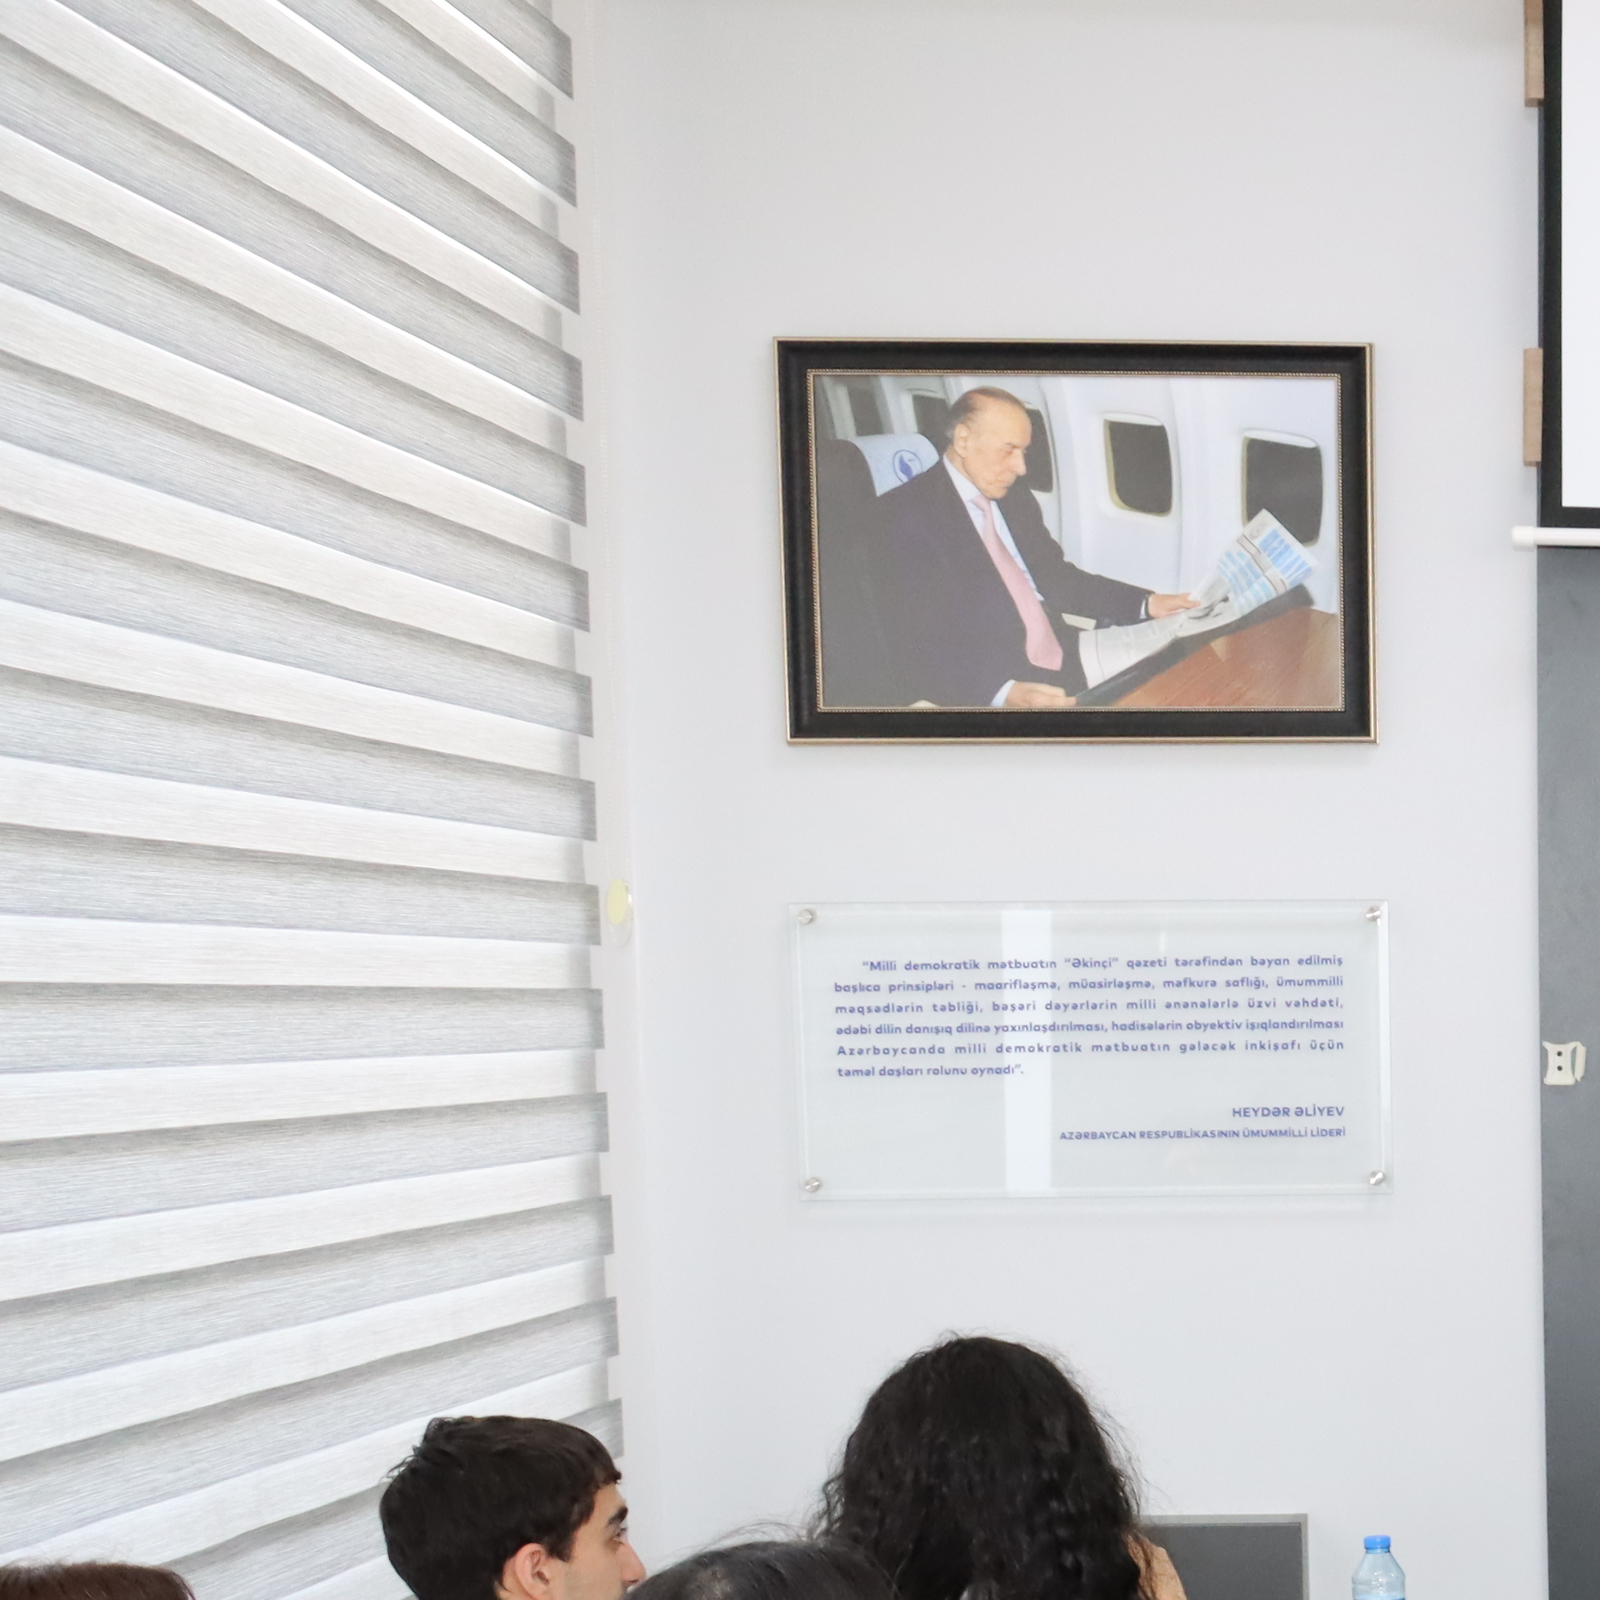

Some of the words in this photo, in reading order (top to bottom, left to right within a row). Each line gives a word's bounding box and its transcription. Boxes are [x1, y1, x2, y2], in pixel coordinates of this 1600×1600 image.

[904, 959, 980, 970] demokratik
[987, 959, 1056, 969] mətbuatın
[1126, 956, 1166, 970] qəzeti
[1174, 956, 1242, 966] tərəfindən
[1250, 955, 1290, 968] bəyan
[1296, 954, 1342, 966] edilmiş
[834, 982, 880, 993] başlıca
[888, 980, 954, 993] prinsipləri
[974, 978, 1060, 990] maarifləşmə,
[1068, 978, 1154, 990] müasirləşmə,
[1162, 977, 1217, 987] məfkurə
[1224, 976, 1268, 989] saflığı,
[1276, 975, 1343, 986] ümummilli
[834, 1002, 923, 1015] məqsədlərin
[932, 1001, 982, 1014] təbliği,
[992, 1000, 1036, 1012] bəşəri
[1044, 999, 1117, 1012] dəyərlərin
[1126, 998, 1156, 1009] milli
[1164, 998, 1238, 1009] ənənələrlə
[1247, 997, 1276, 1008] üzvi
[1284, 997, 1343, 1008] vəhdəti,
[835, 1024, 871, 1035] ədəbi
[874, 1023, 902, 1034] dilin
[905, 1023, 952, 1035] danışıq
[955, 1022, 990, 1033] dilinə
[1111, 1020, 1182, 1031] hadisələrin
[1185, 1019, 1242, 1032] obyektiv
[836, 1044, 945, 1057] Azərbaycanda
[954, 1043, 986, 1053] milli
[995, 1042, 1082, 1053] demokratik
[1091, 1041, 1170, 1052] mətbuatın
[1178, 1040, 1235, 1054] gələcək
[1244, 1039, 1300, 1051] inkişafı
[1309, 1039, 1344, 1051] üçün
[837, 1066, 875, 1077] təməl
[878, 1066, 923, 1077] daşları
[926, 1065, 967, 1075] rolunu
[1232, 1106, 1290, 1117] HEYDƏR
[1294, 1103, 1344, 1117] ƏLİYEV
[1059, 1130, 1136, 1140] AZƏRBAYCAN
[1310, 1126, 1346, 1137] LİDERİ
